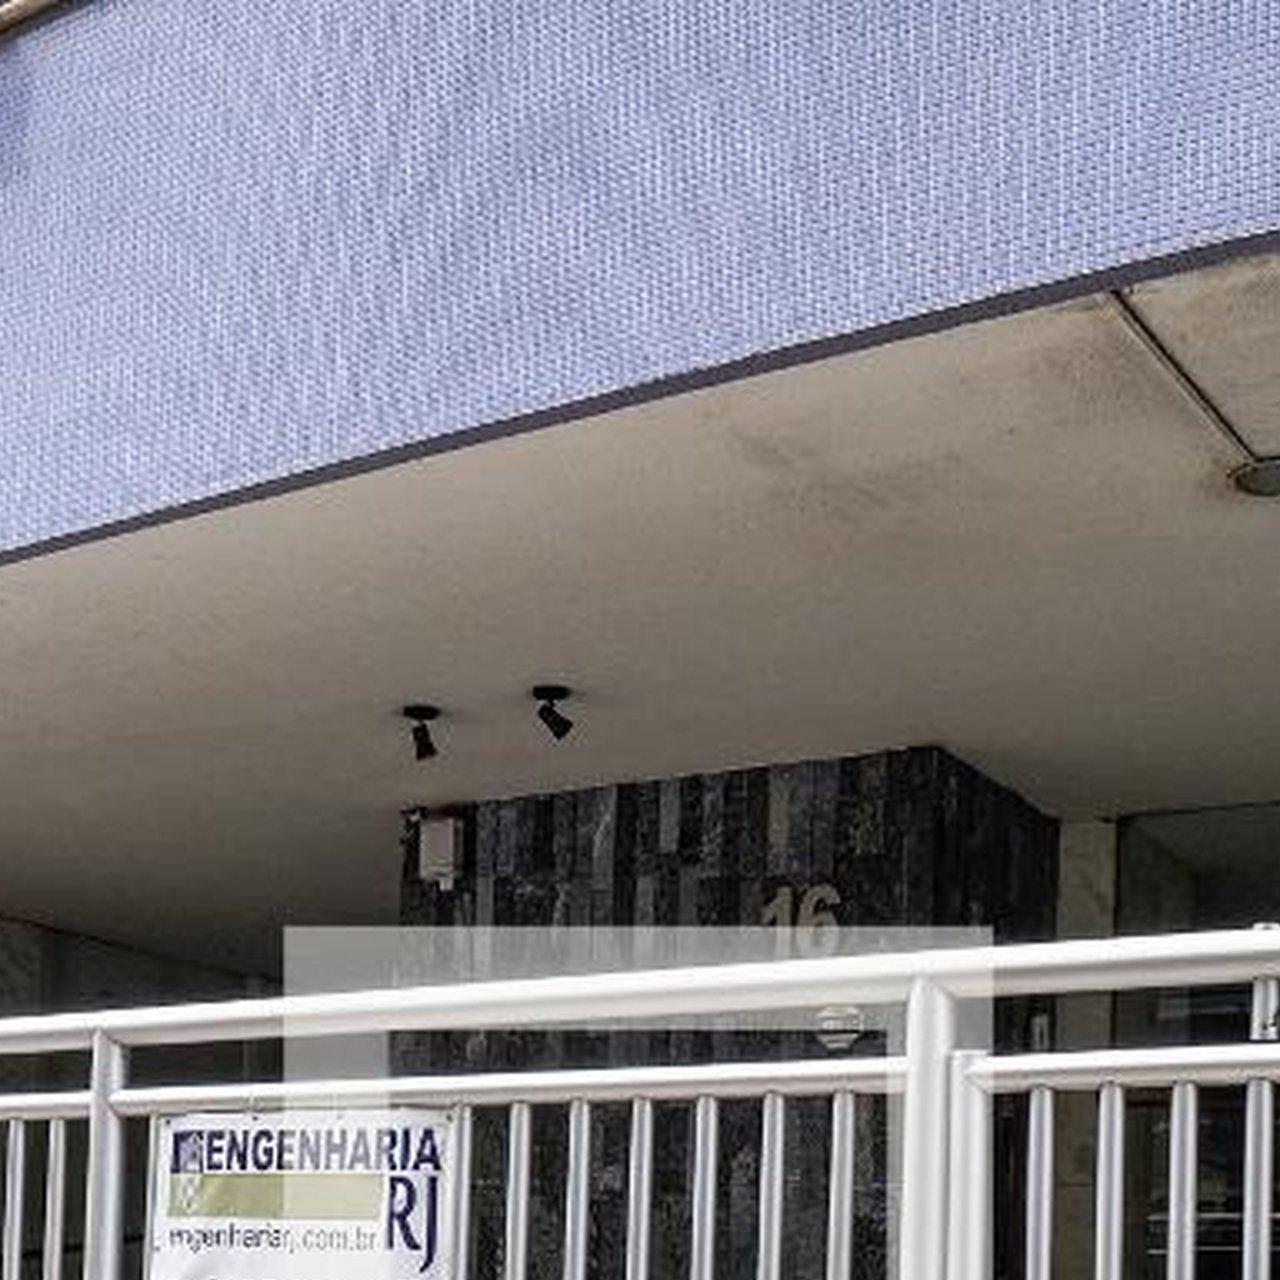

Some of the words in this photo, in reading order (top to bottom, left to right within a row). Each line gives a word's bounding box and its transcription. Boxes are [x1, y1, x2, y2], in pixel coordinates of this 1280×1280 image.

[761, 884, 841, 959] 16
[207, 1128, 442, 1171] ENGENHARIA
[387, 1175, 438, 1273] RJ
